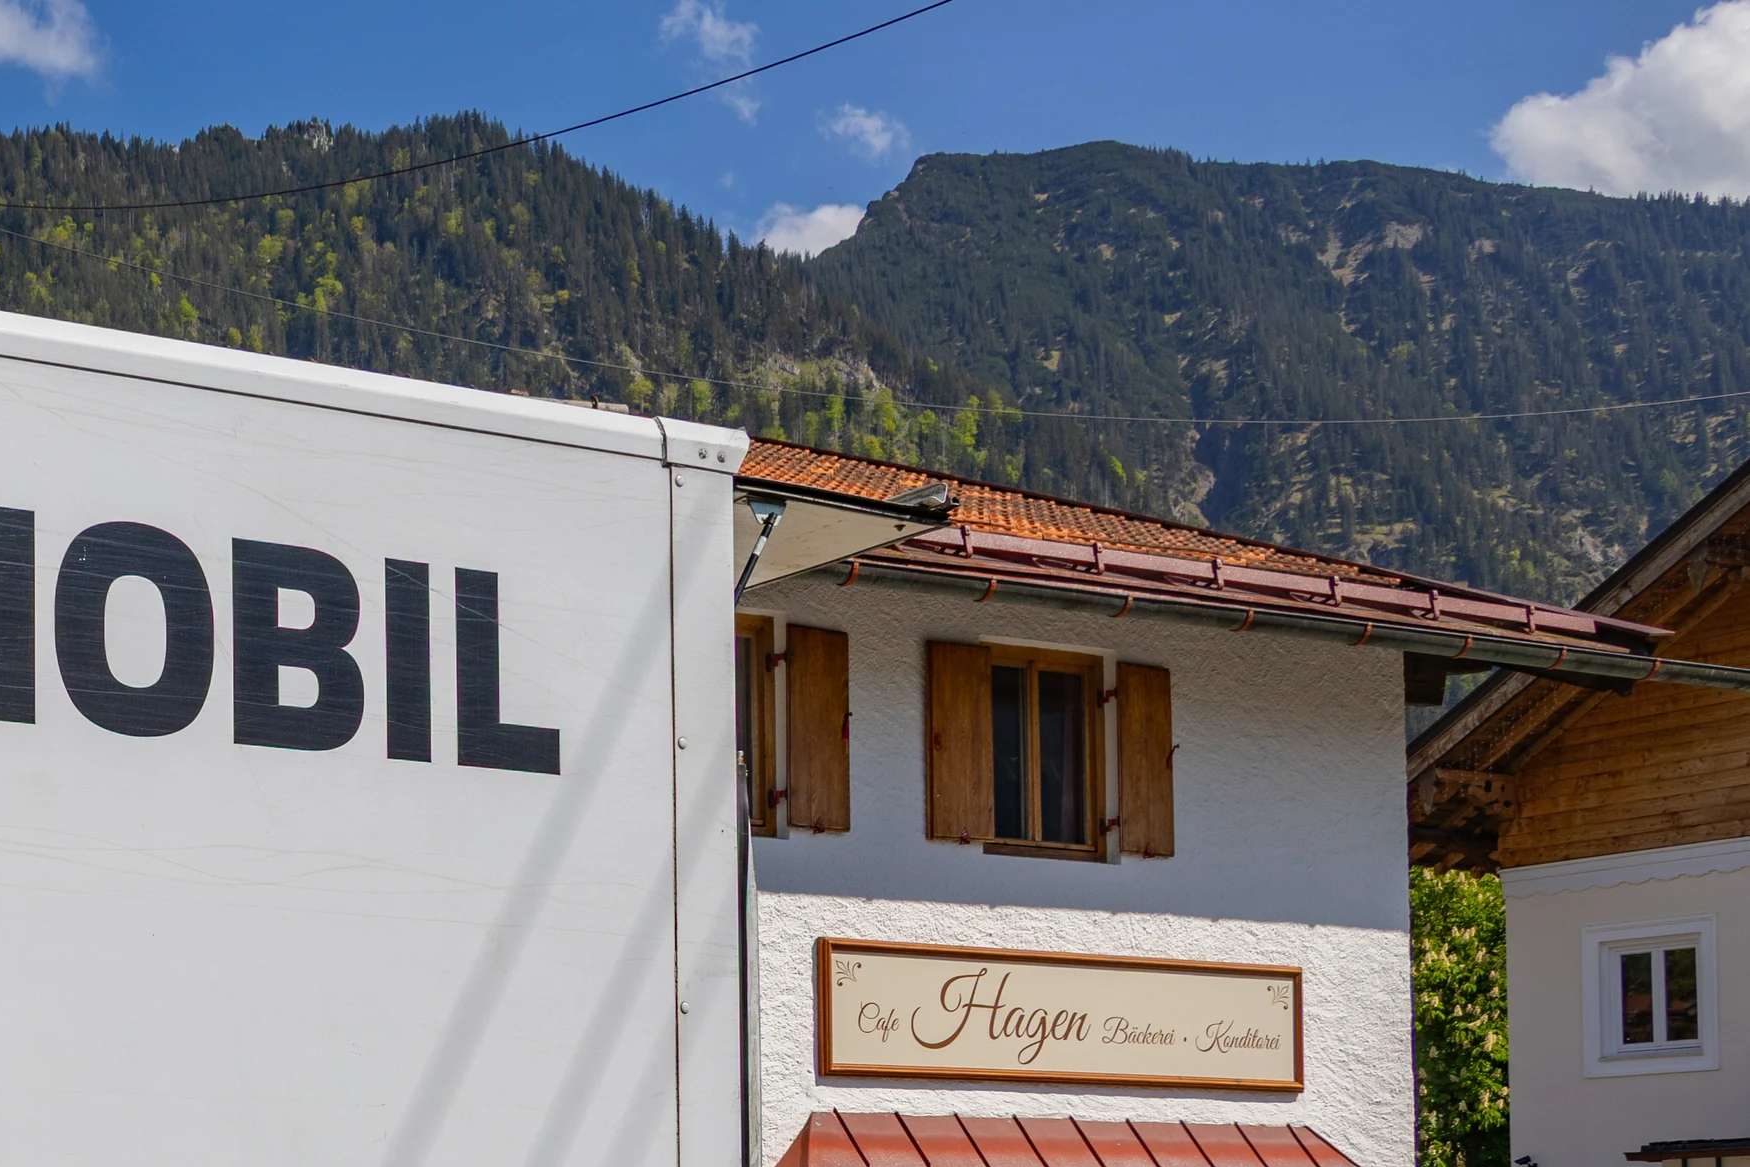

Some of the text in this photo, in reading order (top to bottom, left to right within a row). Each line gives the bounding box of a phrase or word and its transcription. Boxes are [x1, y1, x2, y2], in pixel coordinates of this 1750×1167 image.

[857, 966, 1281, 1065] Cafe Hagen Bäckerei Konditorei
